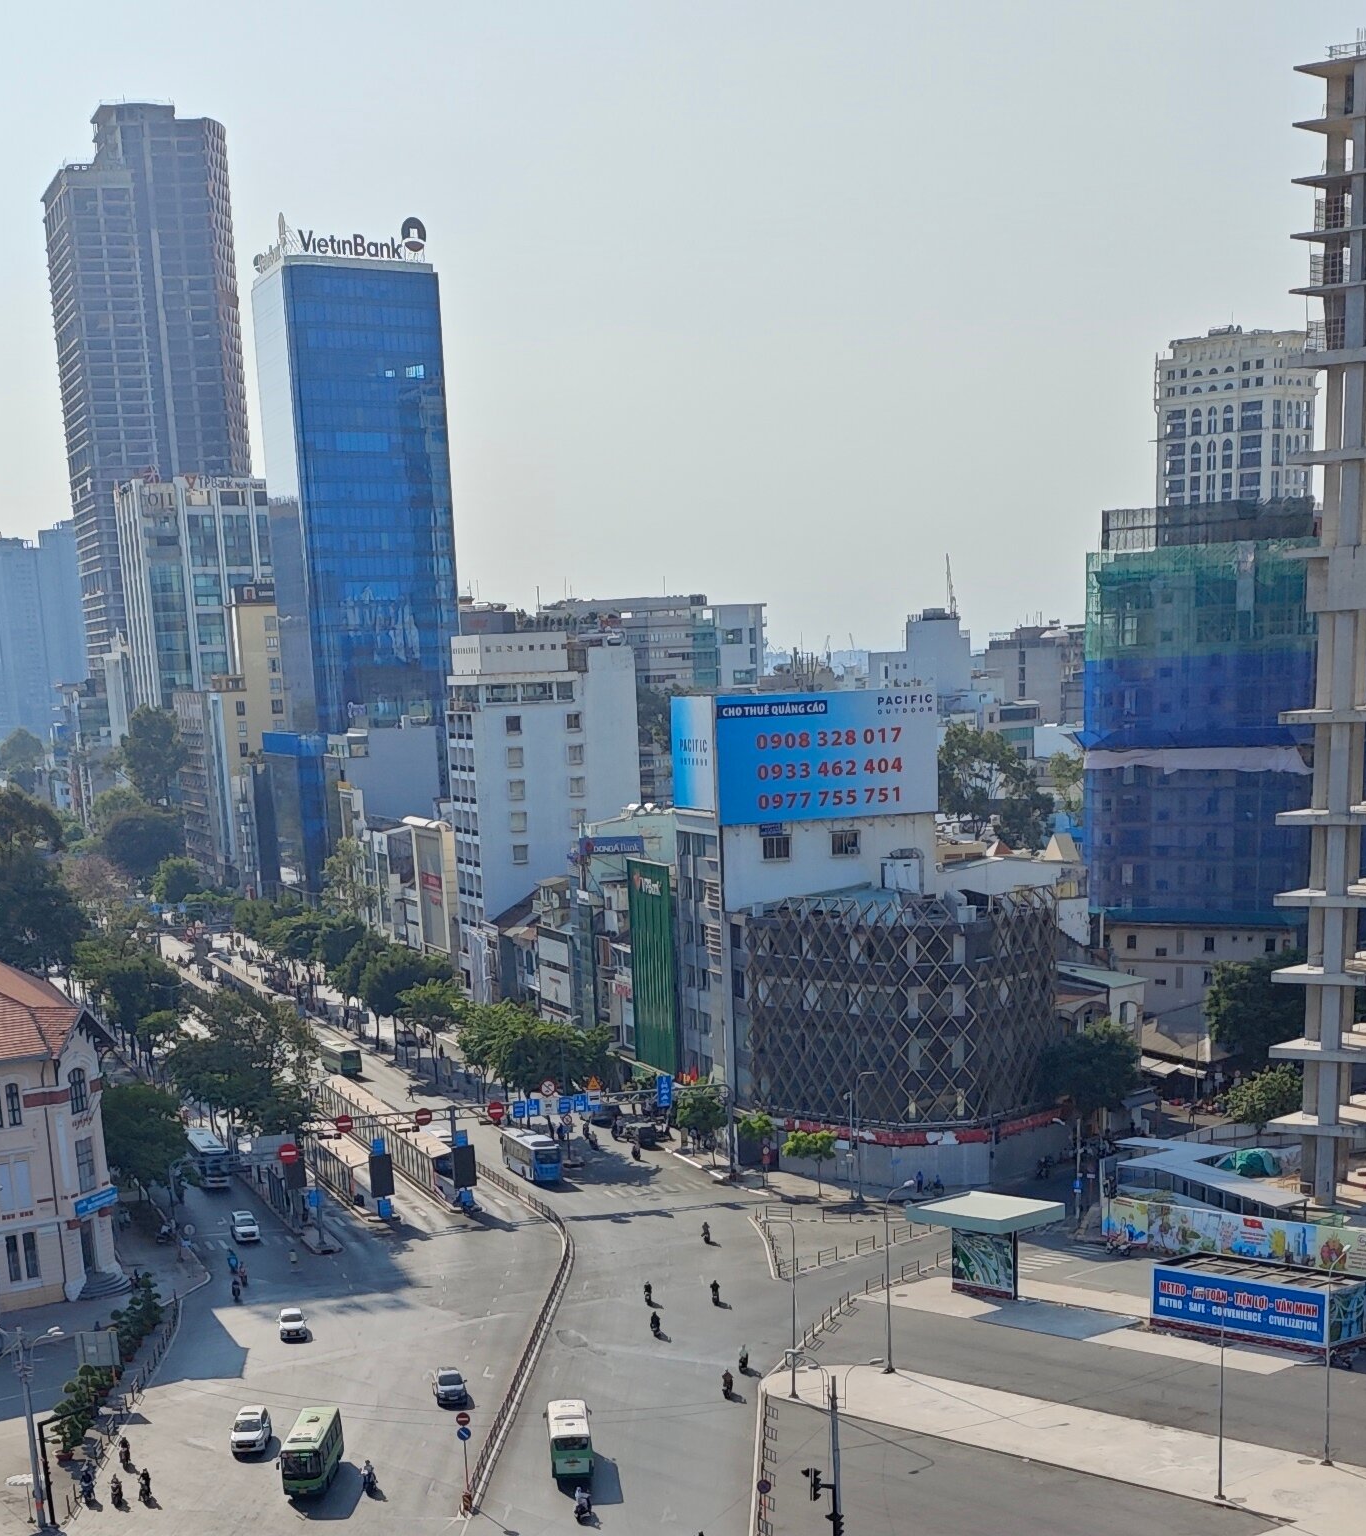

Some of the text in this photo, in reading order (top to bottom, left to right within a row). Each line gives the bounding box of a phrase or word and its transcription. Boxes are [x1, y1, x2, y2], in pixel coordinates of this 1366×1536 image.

[297, 229, 403, 259] VietinBank
[722, 706, 743, 717] CHO
[743, 704, 771, 716] THUÊ
[877, 693, 934, 706] PACIFIC
[877, 706, 934, 715] OUTDOOR
[756, 727, 902, 750] 0908 328 017
[757, 757, 903, 781] 0933 462 404
[758, 786, 901, 810] 0977 755 751
[1159, 1280, 1187, 1297] METRO
[1205, 1287, 1228, 1304] TOÀN
[1294, 1302, 1319, 1318] MINH
[1158, 1296, 1183, 1310] METRO
[1188, 1301, 1206, 1314] SAFE
[1211, 1305, 1262, 1323] CONVENIENCE
[1268, 1316, 1318, 1332] CIVILIZATION
